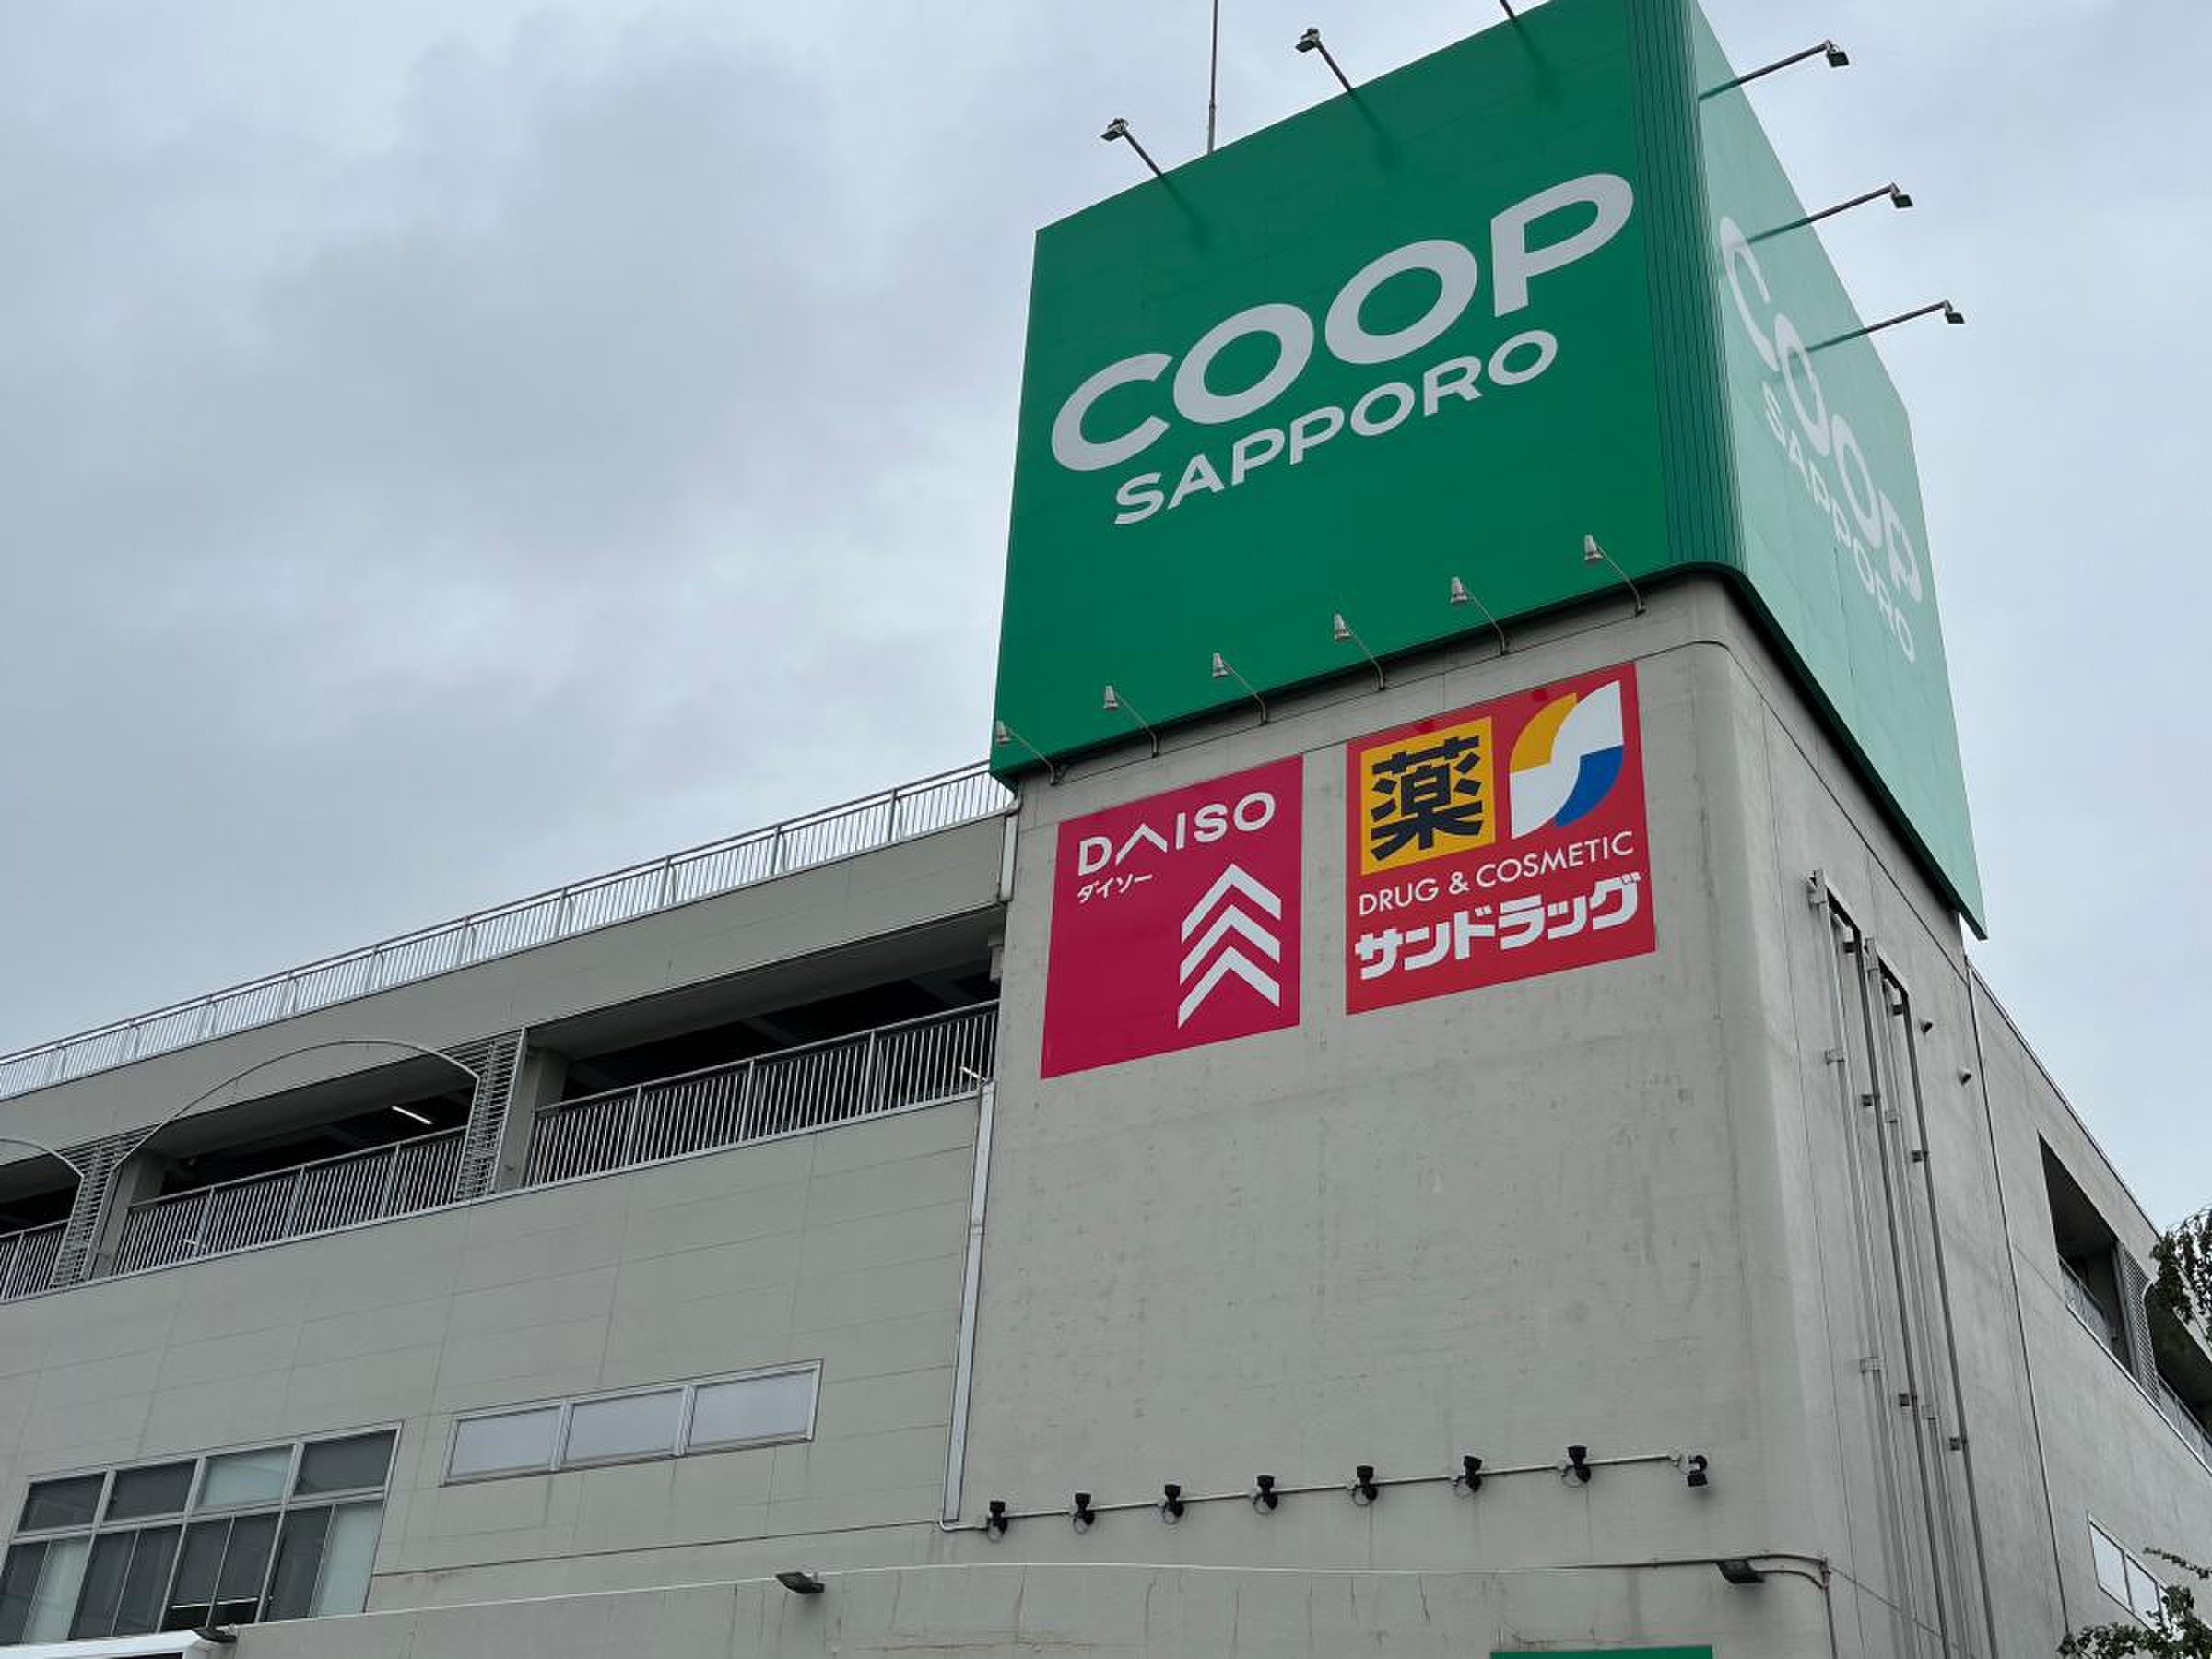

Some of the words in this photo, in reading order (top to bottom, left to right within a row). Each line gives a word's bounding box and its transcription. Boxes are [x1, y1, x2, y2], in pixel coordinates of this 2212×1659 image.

[1051, 173, 1634, 471] COOP
[1113, 329, 1559, 524] SAPPORO
[1720, 216, 1923, 603] COOP
[1762, 381, 1914, 663] SAPPORO
[1077, 792, 1275, 876] DAISO
[1371, 735, 1483, 861] 薬
[1077, 873, 1153, 904] ダイソー
[1355, 872, 1641, 981] サンドラッグ
[1359, 878, 1439, 916] DRUG
[1449, 873, 1470, 896] &
[1475, 830, 1635, 888] COSMETIC
